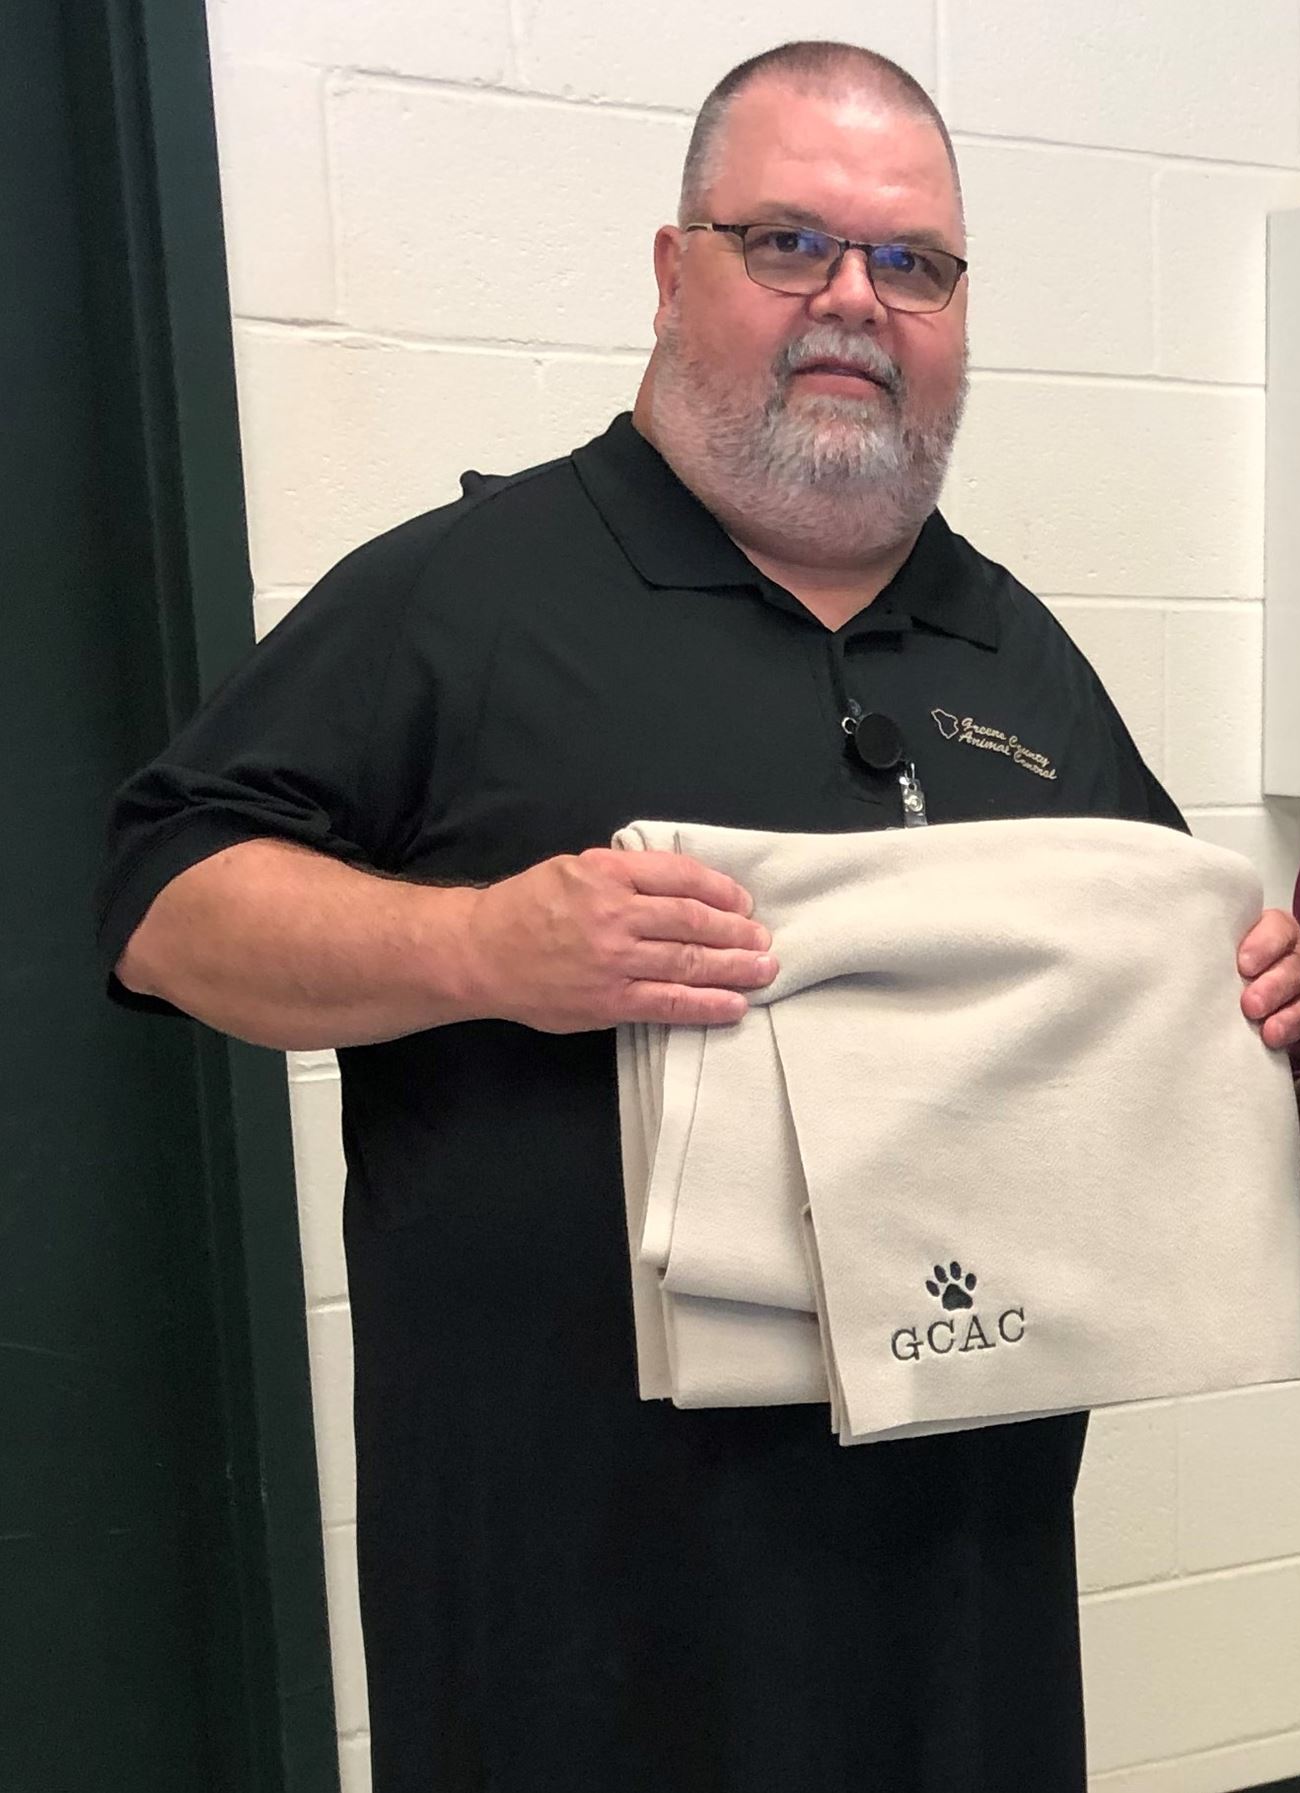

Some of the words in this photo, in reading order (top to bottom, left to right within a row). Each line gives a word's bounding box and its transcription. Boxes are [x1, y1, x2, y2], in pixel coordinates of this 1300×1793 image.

[958, 731, 1012, 756] Animal
[1013, 752, 1057, 780] Control
[1008, 735, 1050, 767] County
[890, 1306, 1028, 1362] GCAC
